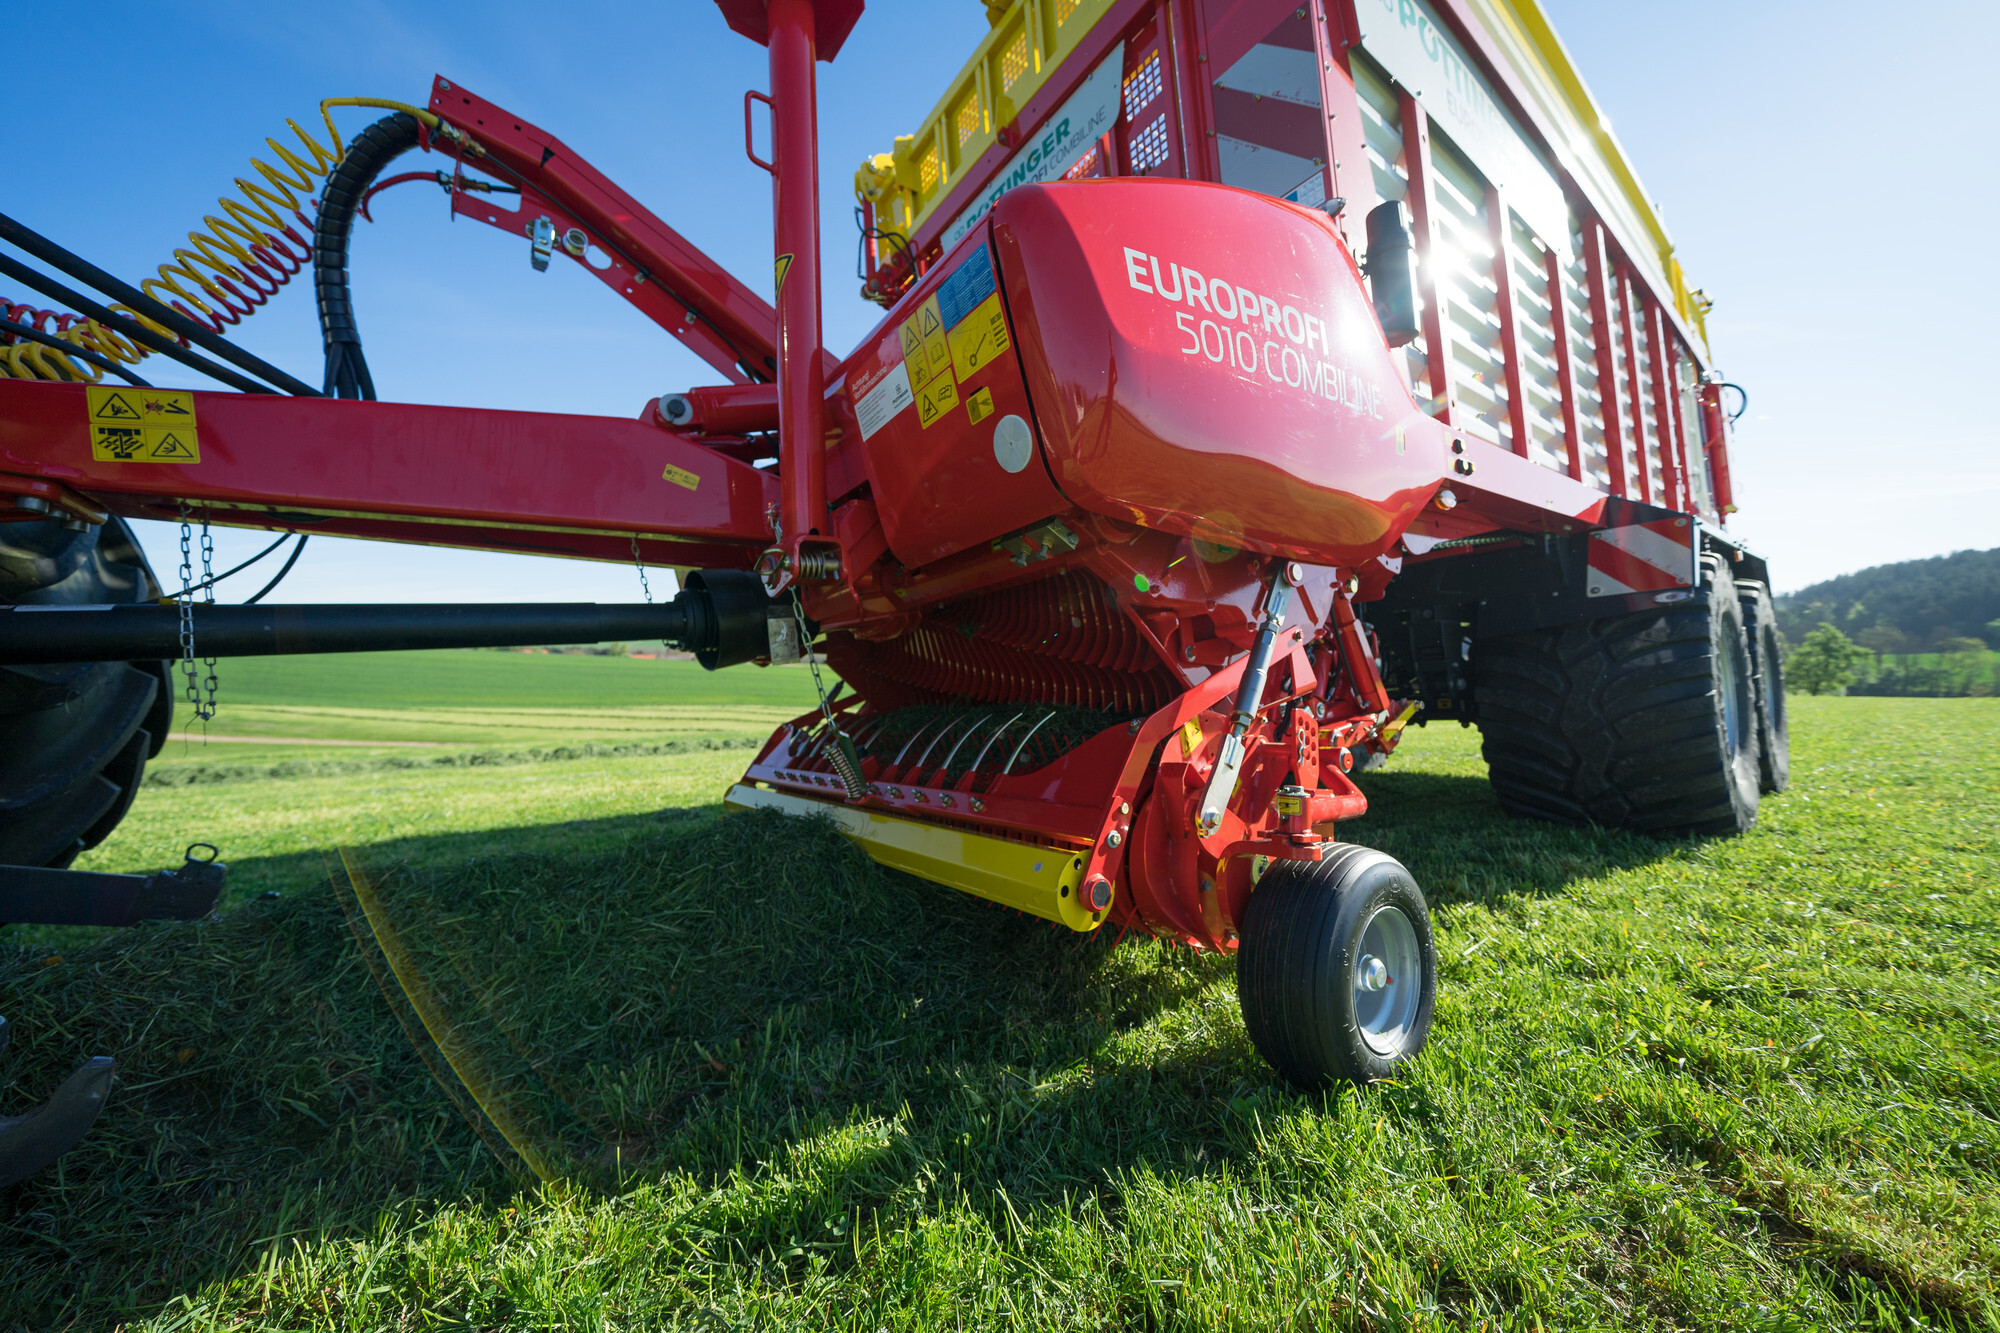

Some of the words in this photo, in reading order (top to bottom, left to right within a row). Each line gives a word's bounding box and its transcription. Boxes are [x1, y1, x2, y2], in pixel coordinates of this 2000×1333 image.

[1398, 0, 1503, 130] PÖTTIN
[1050, 105, 1106, 170] COMBILINE
[1123, 246, 1329, 356] EUROPROFI
[1175, 311, 1258, 374] 5010
[1263, 341, 1384, 421] COMBILINE
